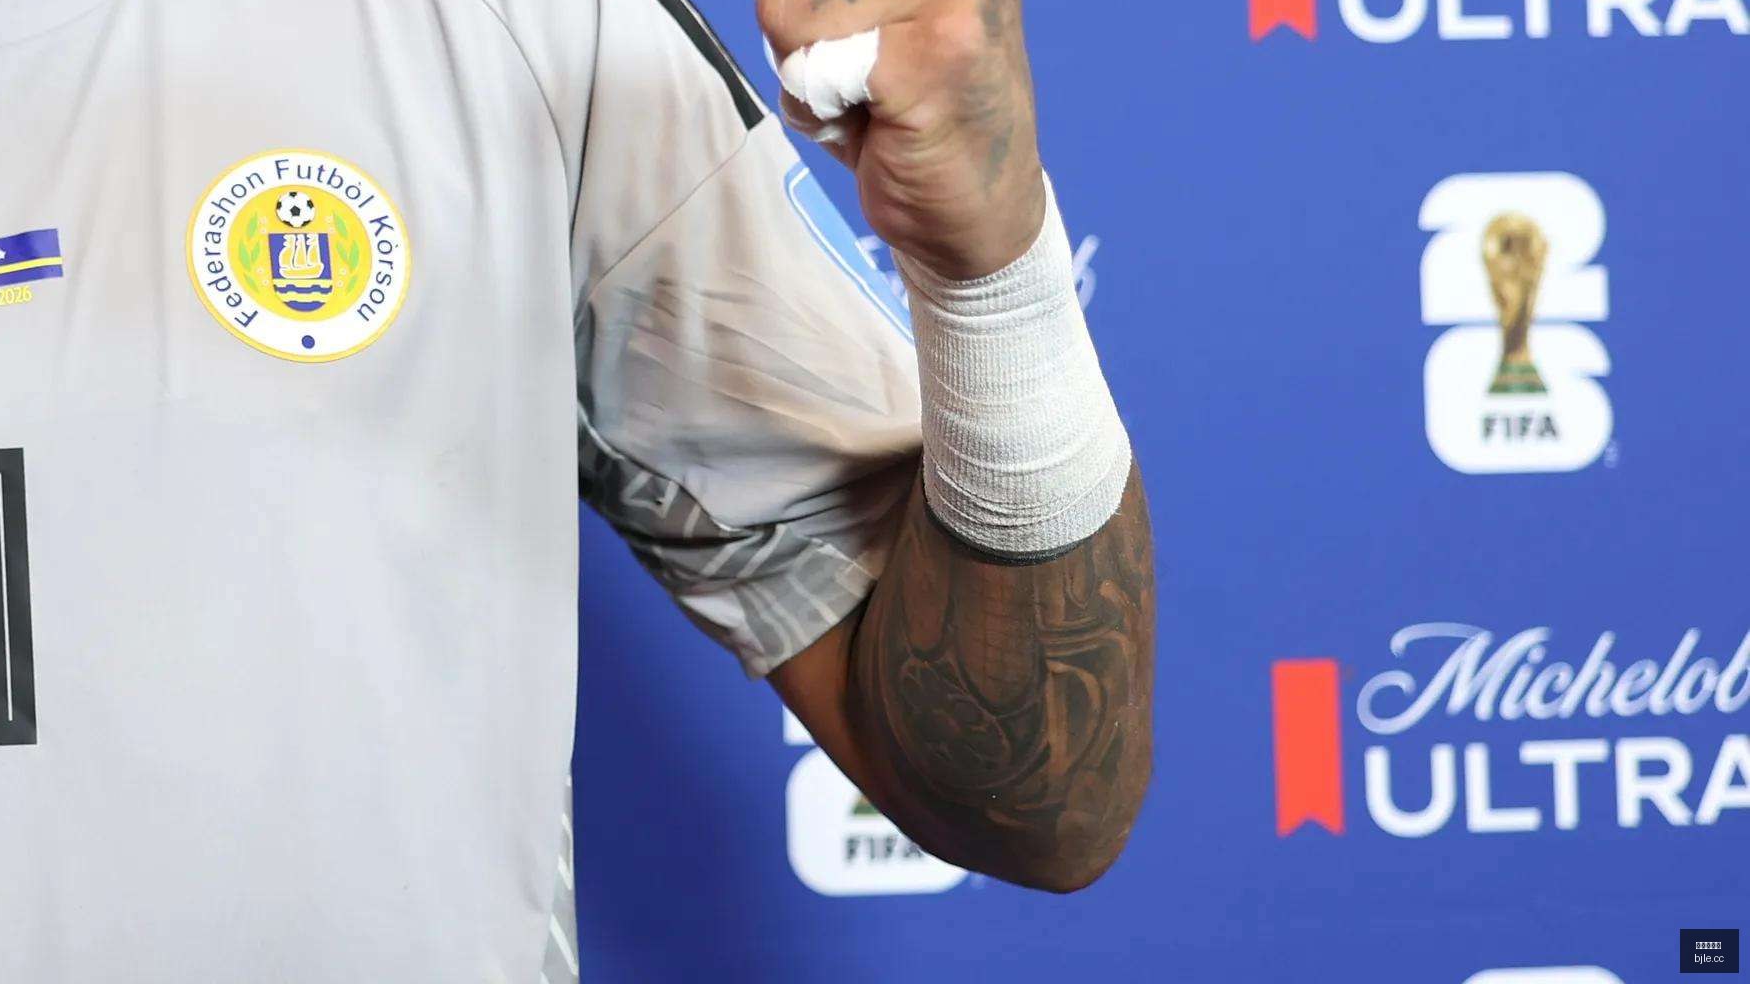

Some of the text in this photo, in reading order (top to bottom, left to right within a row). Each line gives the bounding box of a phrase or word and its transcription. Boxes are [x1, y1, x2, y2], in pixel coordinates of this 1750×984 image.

[204, 171, 265, 328] Federashon
[1481, 412, 1560, 441] FIFA
[1356, 621, 1750, 735] Michelob
